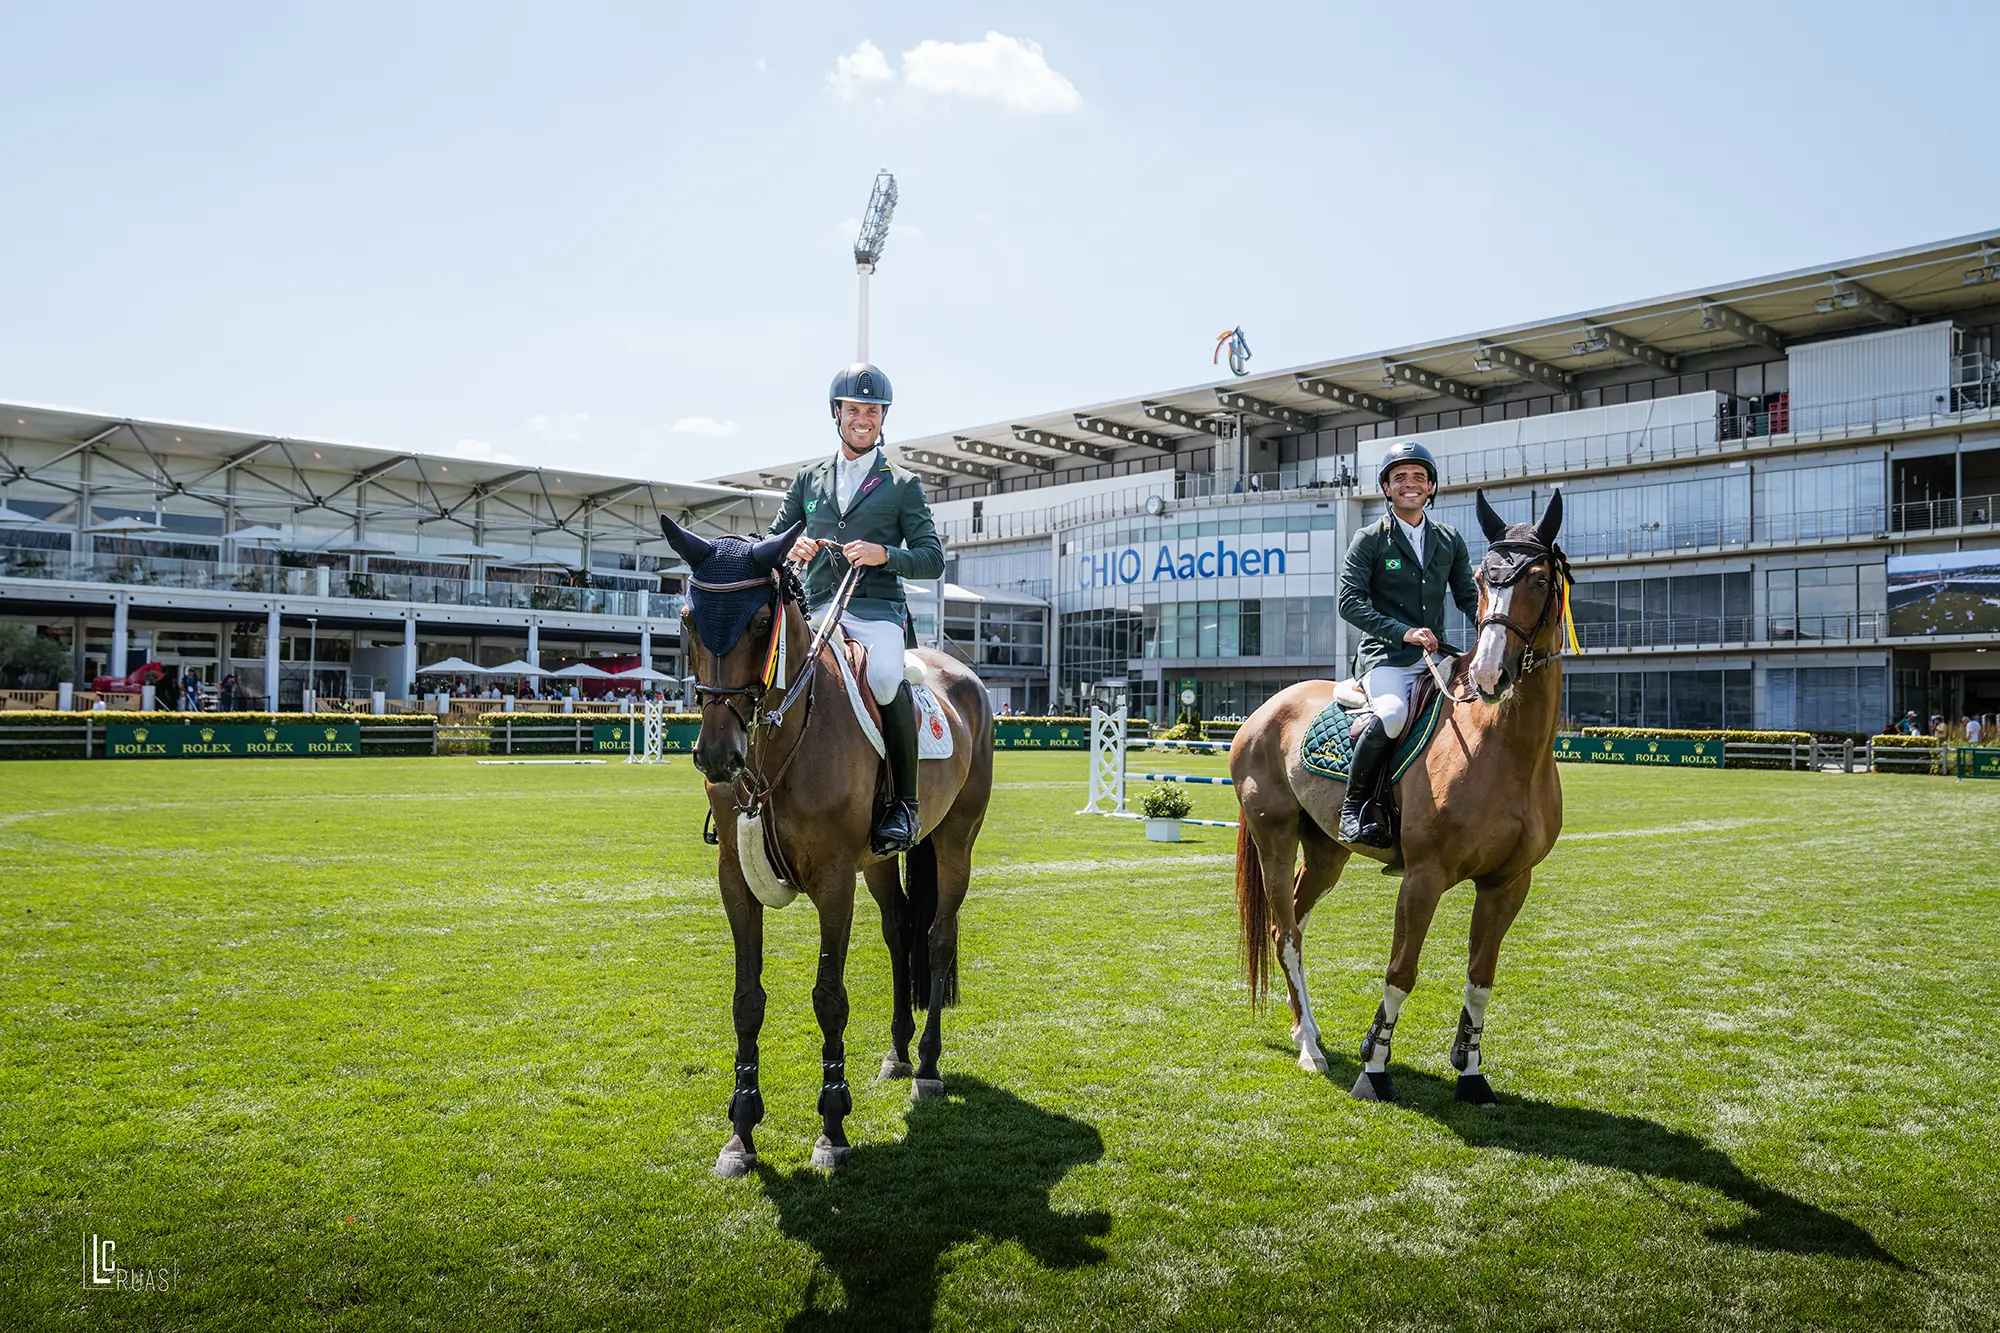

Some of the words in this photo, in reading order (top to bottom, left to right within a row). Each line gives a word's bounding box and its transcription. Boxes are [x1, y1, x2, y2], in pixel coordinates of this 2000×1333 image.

[1078, 549, 1141, 589] CHIO
[1152, 540, 1285, 581] Aachen
[114, 744, 166, 754] ROLEX
[182, 744, 232, 753] ROLEX
[247, 743, 294, 752] ROLEX
[308, 743, 353, 752] ROLEX
[1014, 739, 1042, 747] ROLEX
[1050, 739, 1079, 747] ROLEX
[1591, 752, 1625, 760] ROLEX
[1635, 753, 1670, 763] ROLEX
[1681, 755, 1717, 764] ROLEX
